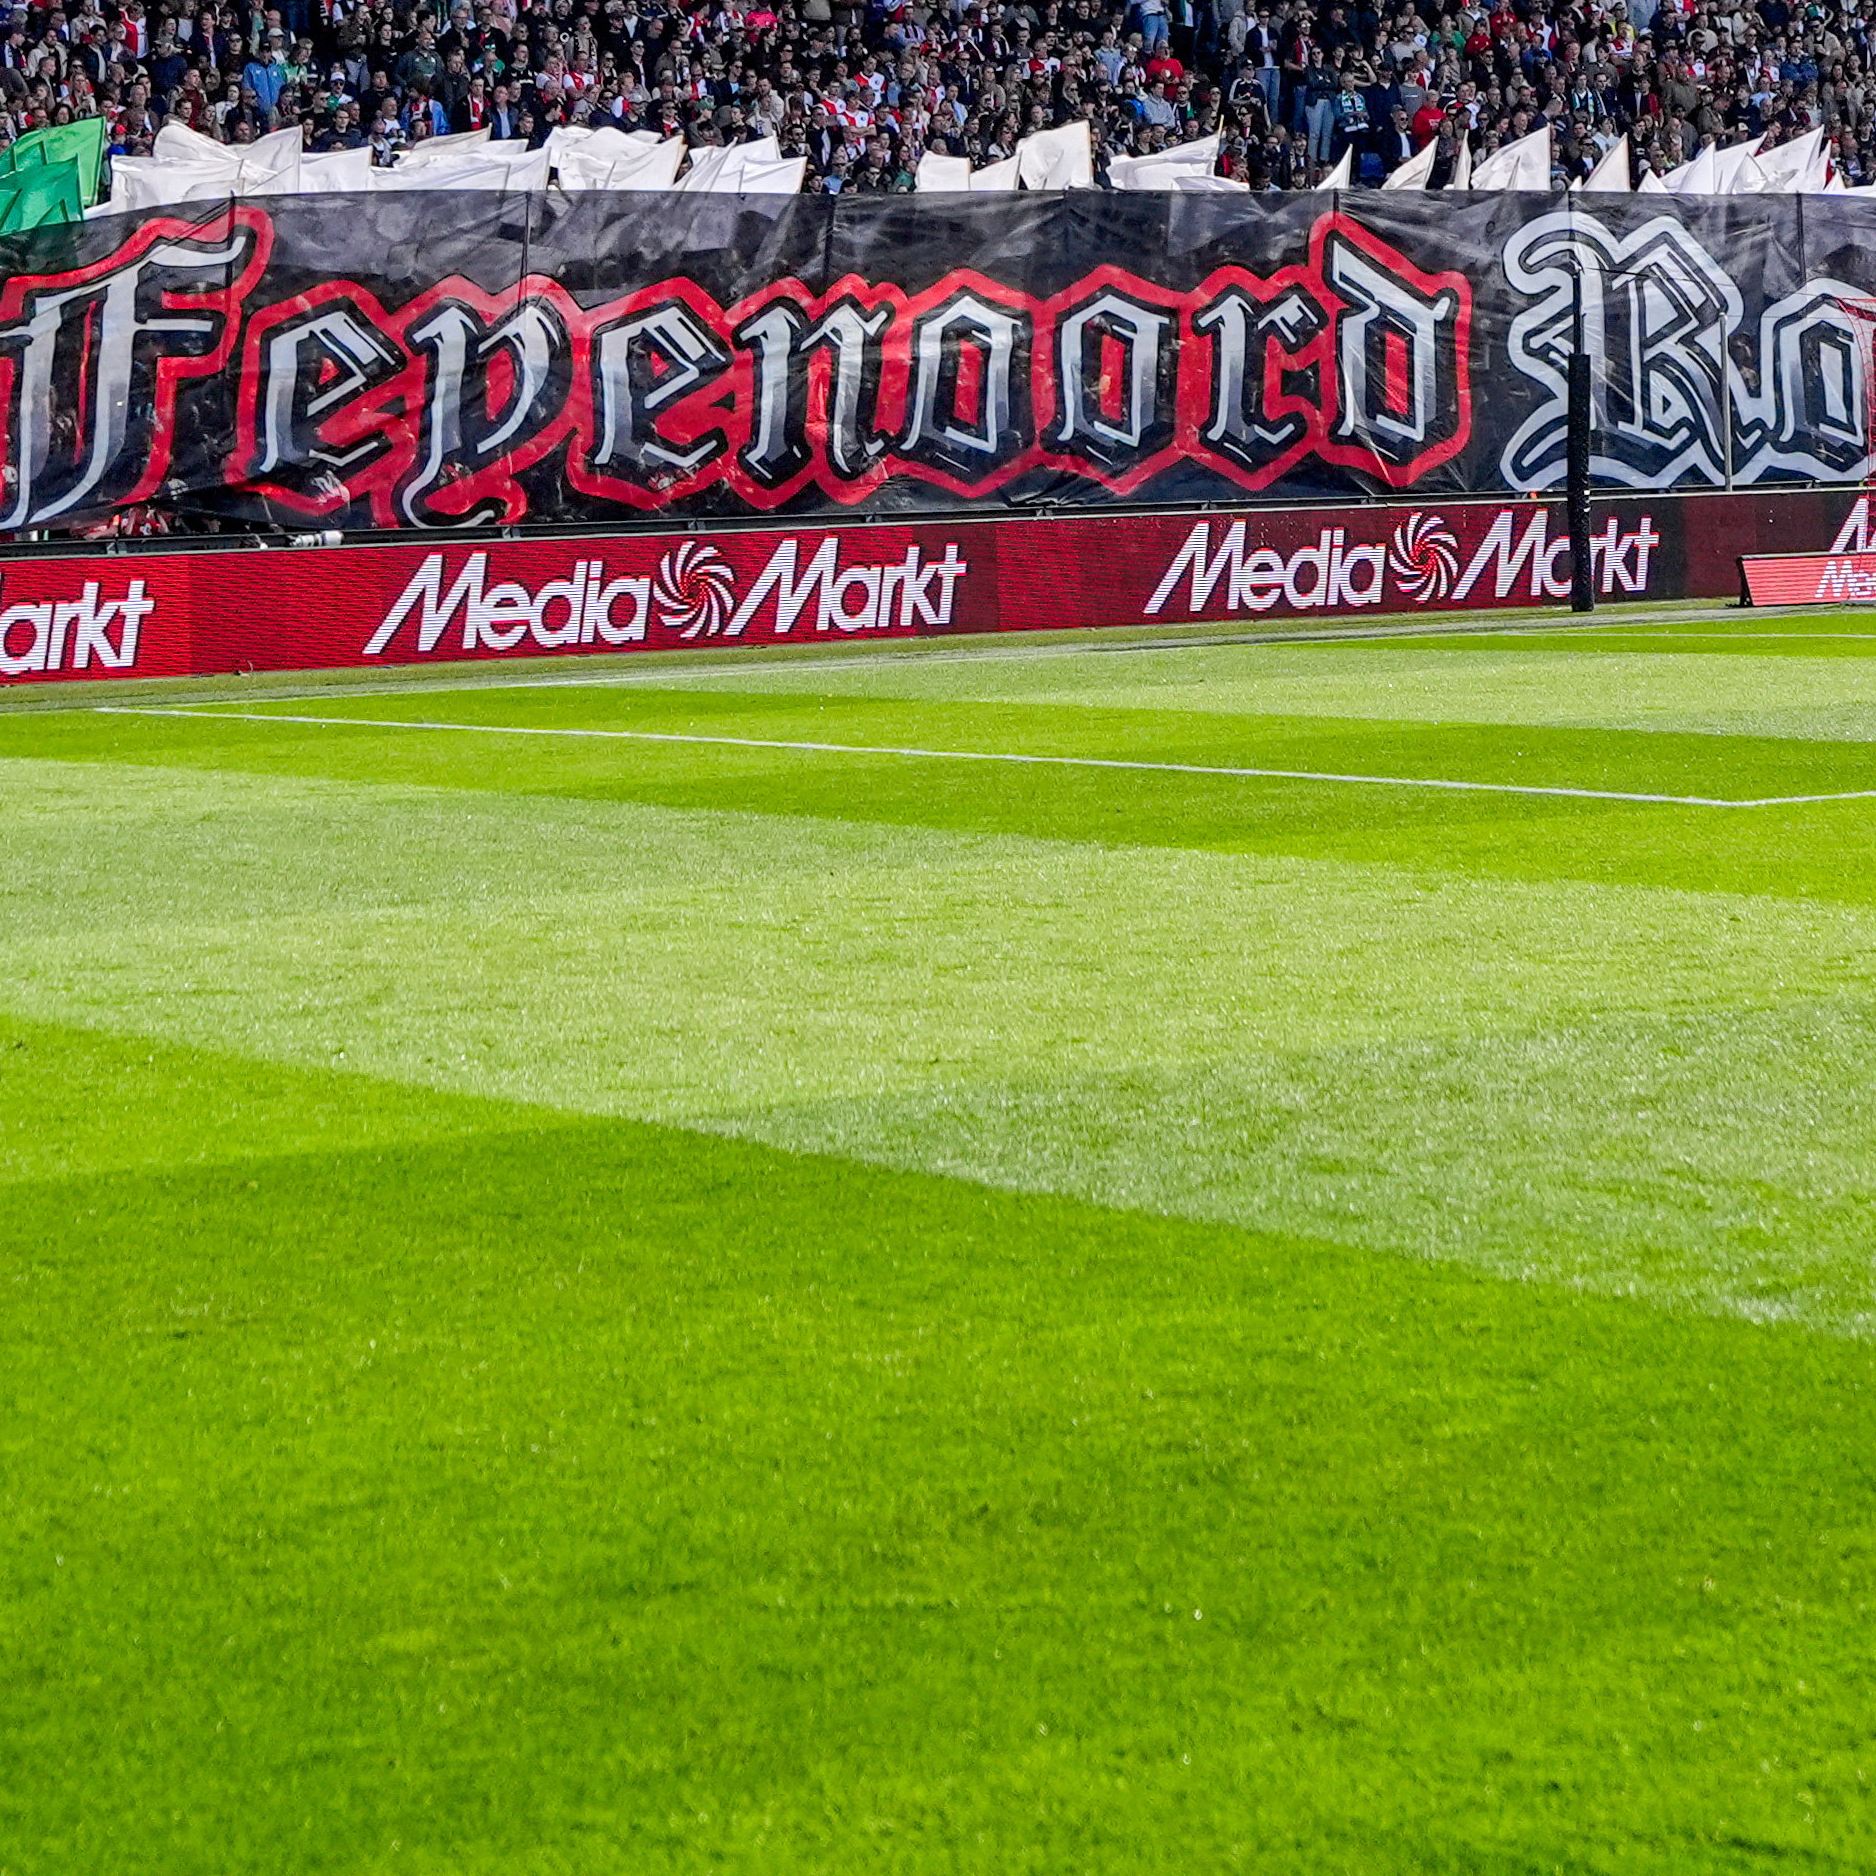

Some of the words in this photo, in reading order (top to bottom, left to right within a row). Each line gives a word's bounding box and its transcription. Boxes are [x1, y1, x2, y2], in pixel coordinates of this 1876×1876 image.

[362, 550, 652, 656] Media
[723, 536, 968, 636] Markt
[1142, 520, 1387, 615] Media
